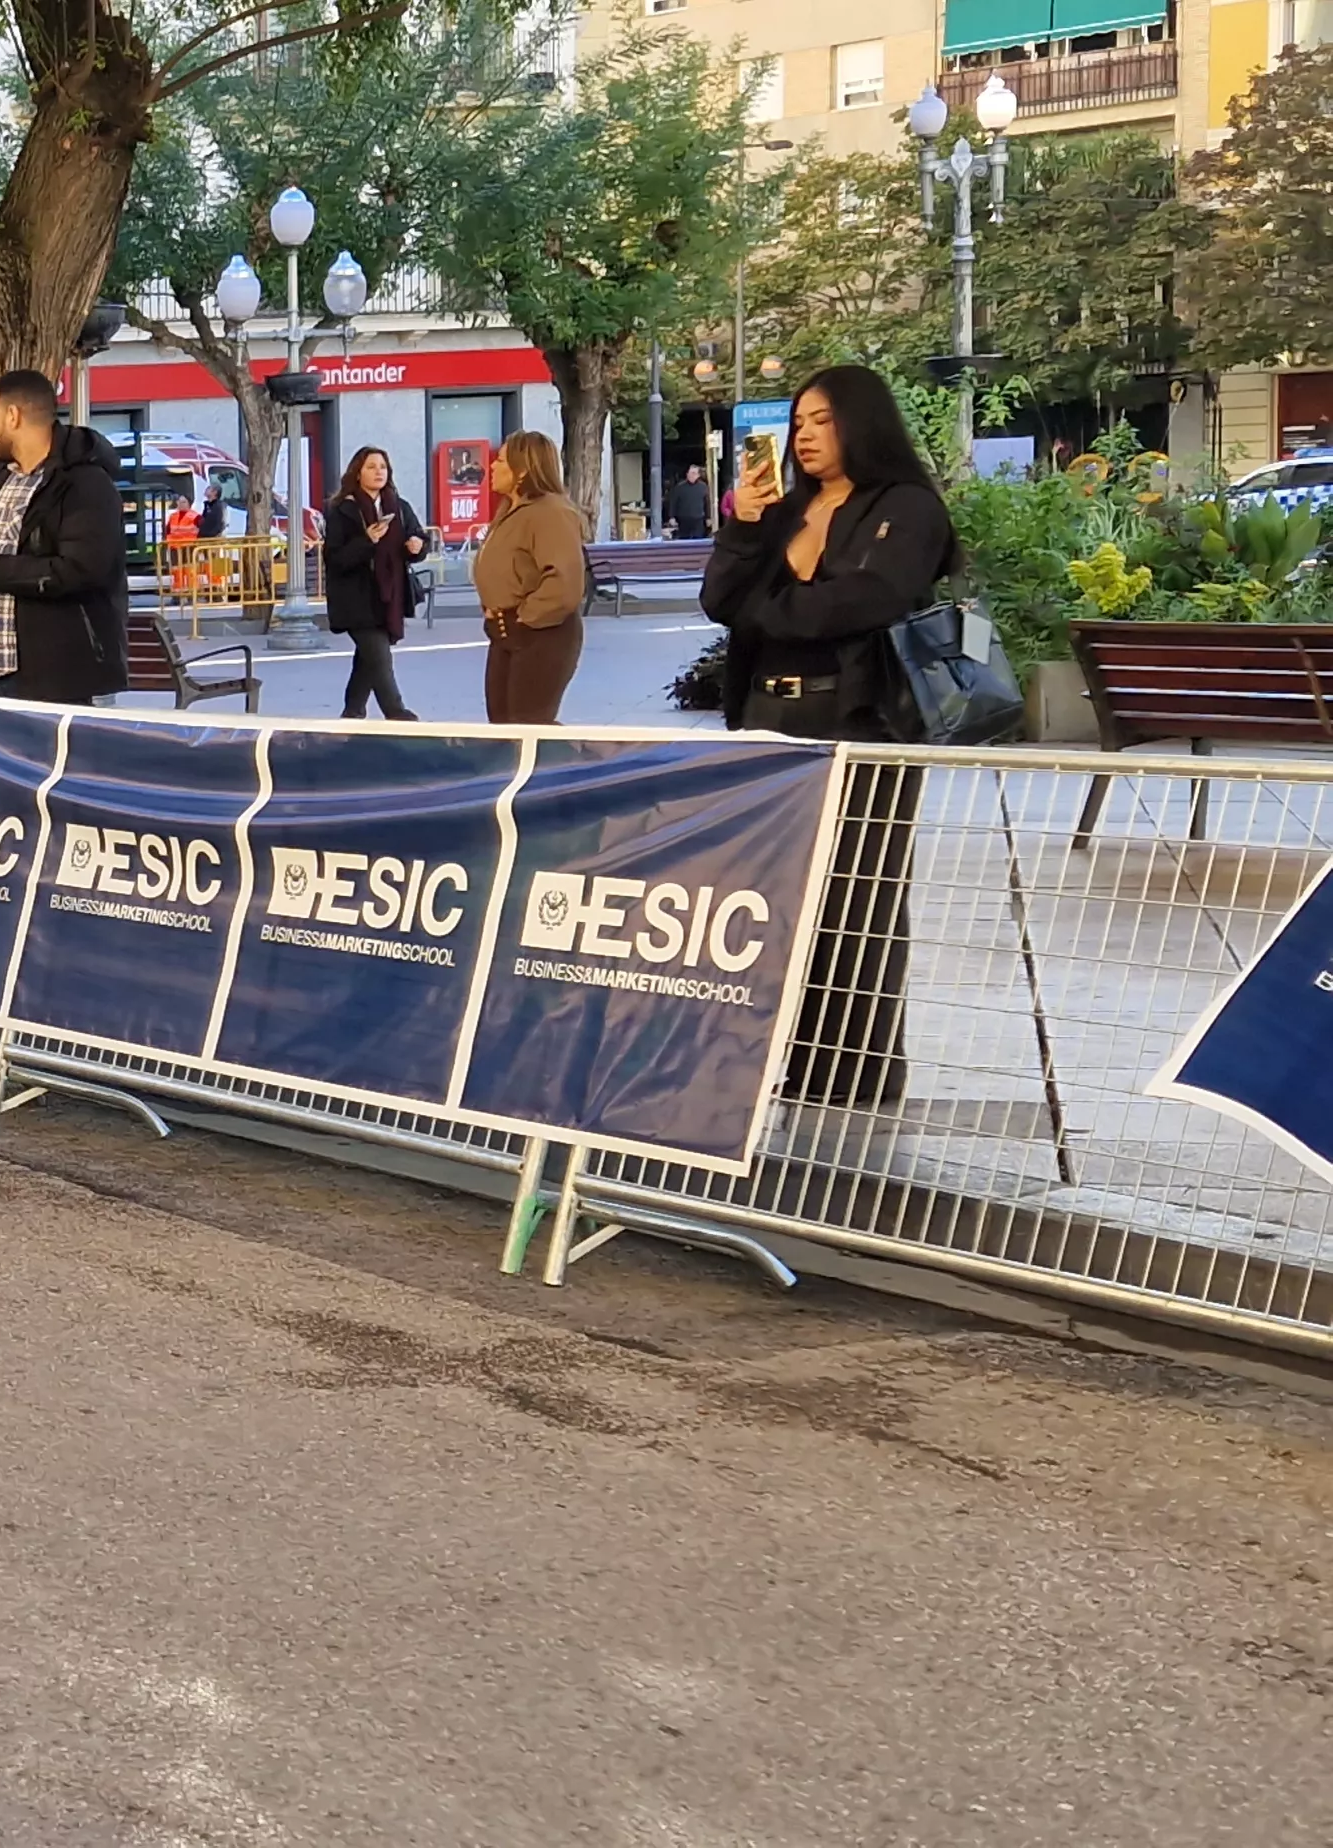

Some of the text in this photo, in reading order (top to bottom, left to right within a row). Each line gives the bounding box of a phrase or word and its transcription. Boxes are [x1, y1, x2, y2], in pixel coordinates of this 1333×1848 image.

[743, 406, 787, 419] HUESC
[97, 828, 222, 906] ESIC
[50, 894, 213, 933] BUSINESS&MARKETINGSCHOOL
[318, 851, 468, 937] ESIC
[261, 924, 456, 967] BUSINESS&MARKETINGSCHOOL
[579, 877, 770, 973] ESIC
[514, 958, 755, 1007] BUSINESS&MARKETINGSCHOOL
